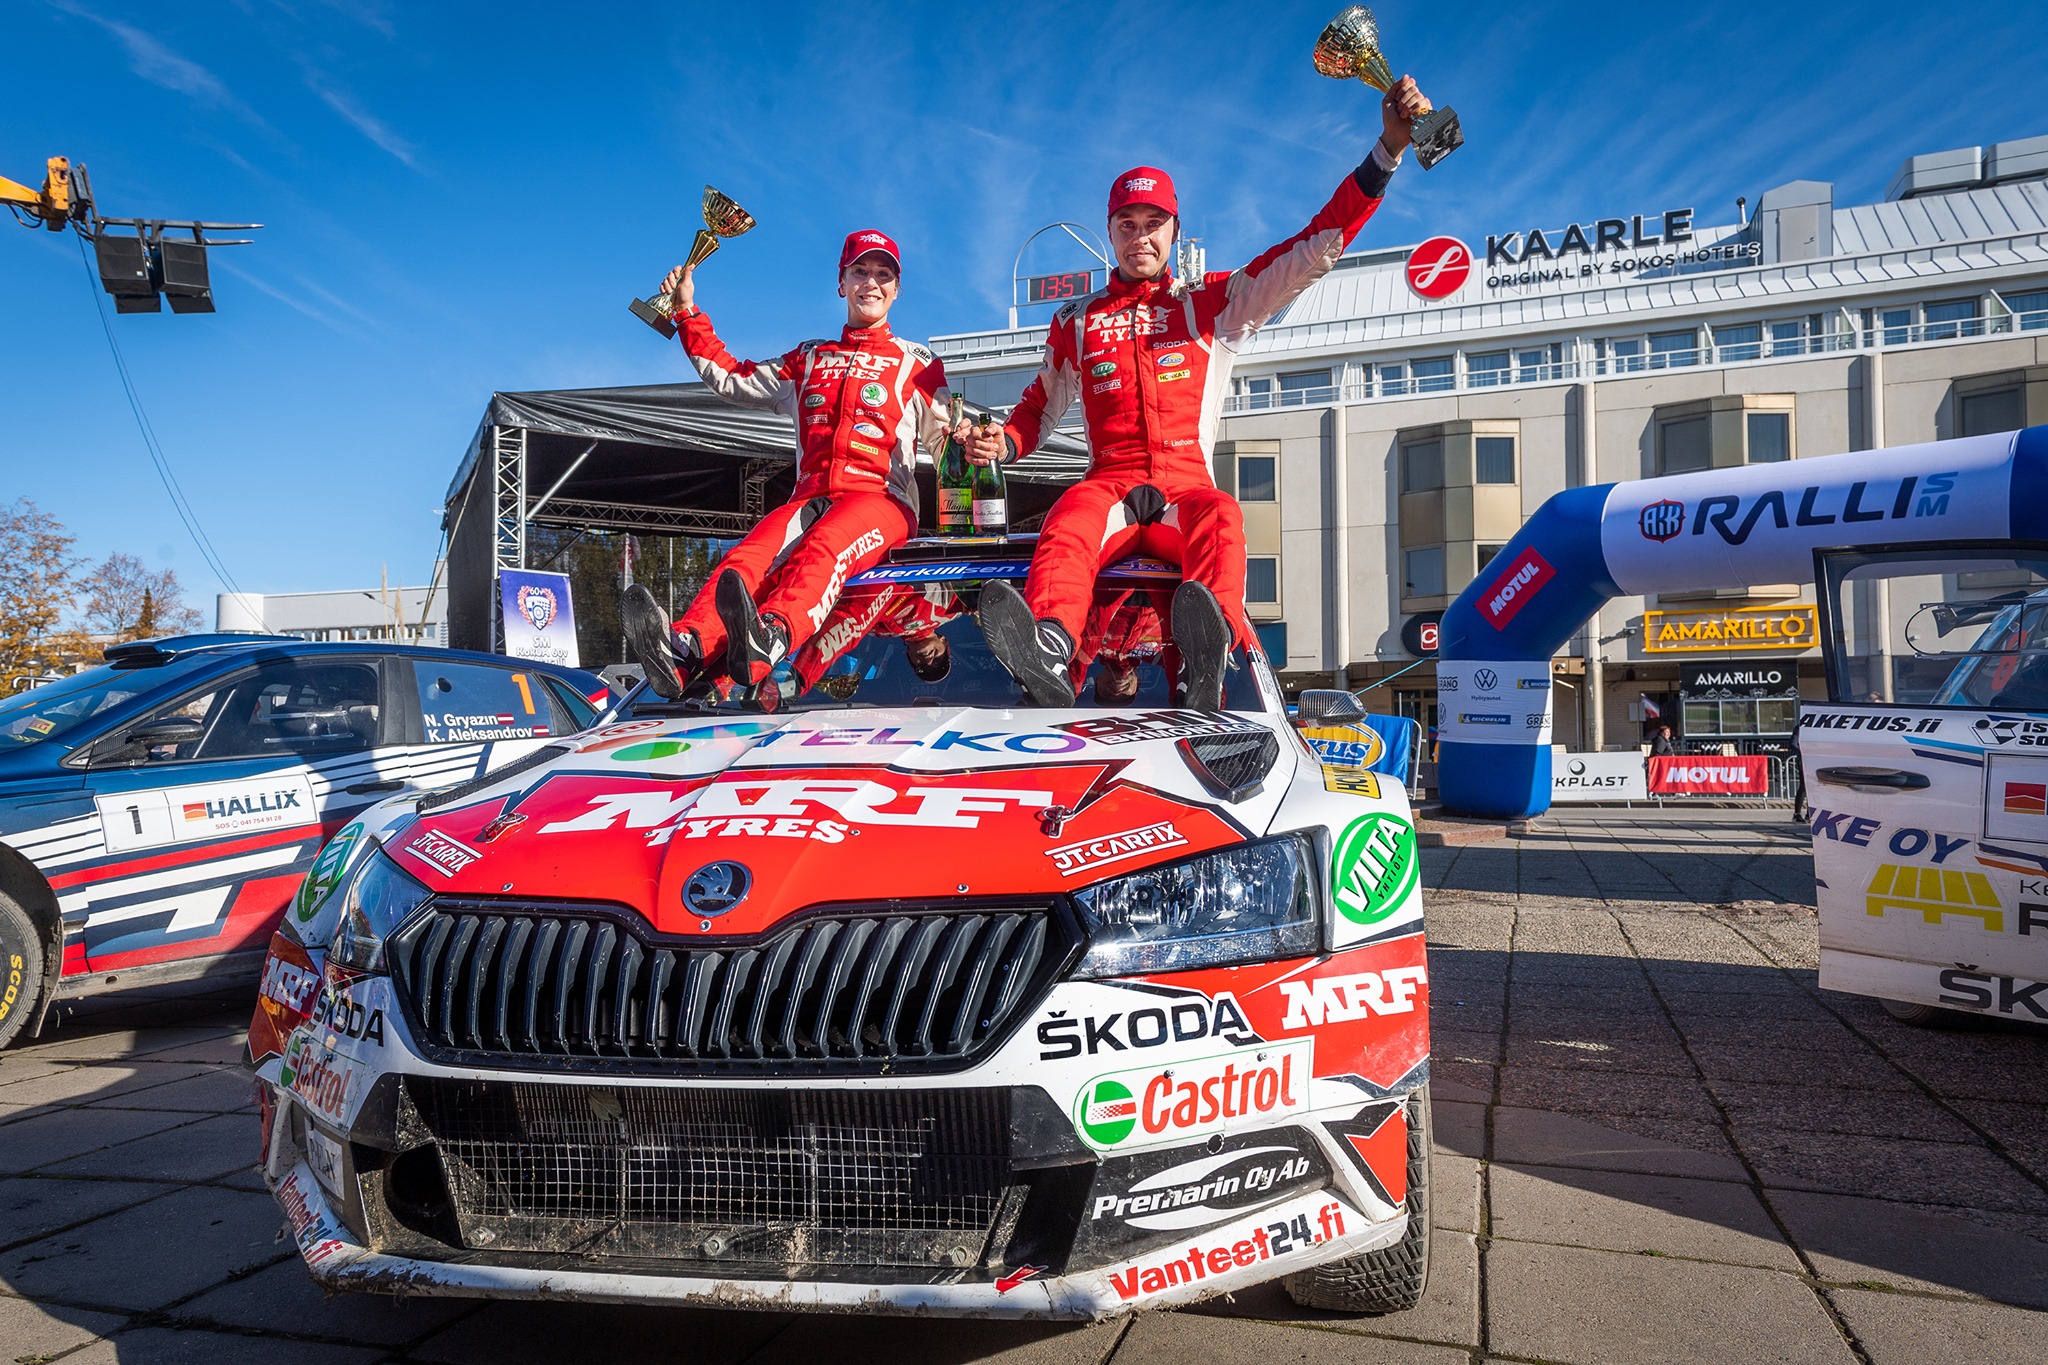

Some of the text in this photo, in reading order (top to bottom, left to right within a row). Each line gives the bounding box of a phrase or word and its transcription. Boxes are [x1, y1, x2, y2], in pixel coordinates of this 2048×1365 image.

[1125, 178, 1157, 188] MRF
[1486, 207, 1694, 268] KAARLE
[1486, 242, 1761, 290] ORIGINAL BY SOKOS HOTELS
[1040, 272, 1090, 298] 13:57
[1061, 303, 1078, 318] OMP
[1087, 303, 1176, 332] MRF
[1100, 318, 1169, 343] TYRES
[1153, 339, 1189, 350] ŠKODA
[815, 351, 900, 372] MRF
[913, 347, 931, 360] OMP
[821, 367, 882, 380] TYRES
[1643, 476, 1919, 546] AKK RALLI
[843, 527, 885, 567] TYRES
[859, 564, 1014, 580] Merkillisen
[1490, 562, 1540, 616] MOTUL
[532, 636, 551, 648] SM
[1658, 616, 1806, 641] AMARILLO
[1695, 671, 1782, 685] AMARILLO
[511, 673, 536, 715] 1
[424, 713, 498, 729] N. Gryazin
[428, 727, 532, 742] K. Aleksandrov
[750, 728, 1087, 754] TELKO
[1551, 776, 1628, 787] KPLAST
[1666, 767, 1750, 783] MOTUL
[206, 789, 301, 819] HALLIX
[536, 782, 1052, 834] MRF
[126, 805, 143, 835] 1
[215, 822, 230, 830] SOS
[646, 817, 850, 847] TYRES
[1812, 810, 1971, 864] KE OY
[260, 956, 320, 1013] MRF
[1279, 965, 1428, 1030] MRF
[1037, 998, 1250, 1060] ŠKODA
[294, 1044, 353, 1118] Castrol
[1142, 1054, 1297, 1134] Castrol
[1091, 1156, 1310, 1220] Premarin Oy Ab
[1109, 1202, 1346, 1301] Vanteet24.fi
